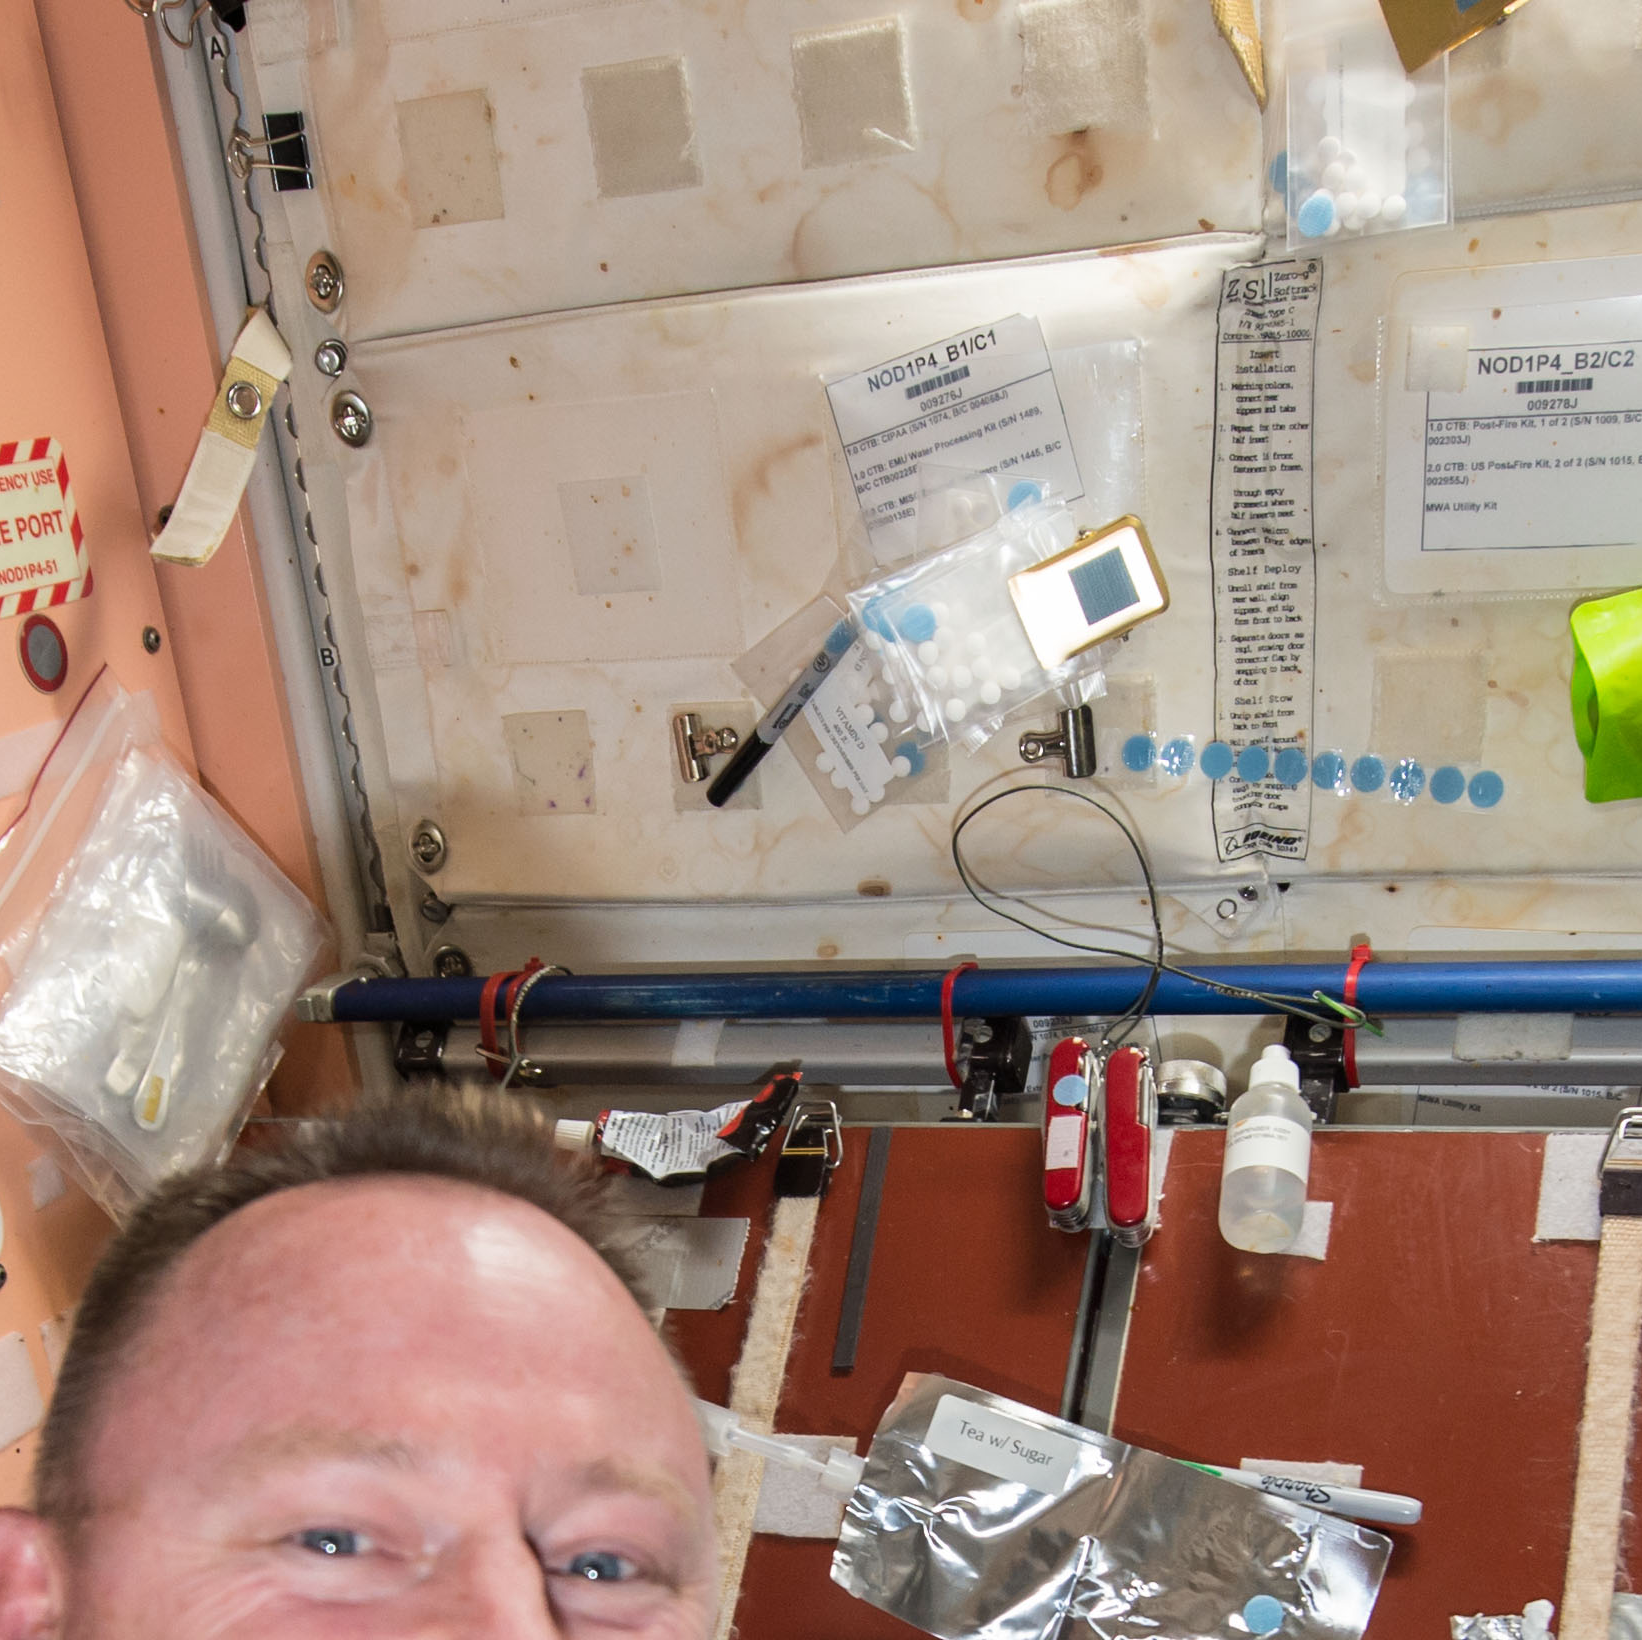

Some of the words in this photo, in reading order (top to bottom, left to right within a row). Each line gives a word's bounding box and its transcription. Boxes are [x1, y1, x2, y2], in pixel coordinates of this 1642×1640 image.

[209, 36, 225, 62] A
[867, 329, 998, 393] NOD1P4_B1/C1
[1477, 348, 1636, 376] NOD1P4_B2/C2
[919, 387, 964, 413] 009276J
[1526, 397, 1579, 412] 009278J
[1429, 421, 1444, 433] 1.0
[1444, 420, 1471, 432] CTB:
[1472, 418, 1519, 431] Post-Fire
[1519, 417, 1539, 430] Kit,
[1548, 416, 1560, 428] of
[1560, 416, 1568, 427] 2
[1569, 415, 1593, 428] (S/N
[1622, 412, 1642, 425] B/C
[888, 454, 909, 469] EMU
[908, 446, 935, 462] Water
[933, 426, 984, 456] Processing
[983, 421, 999, 436] Kit
[998, 413, 1019, 431] (S/N
[1043, 439, 1063, 454] B/C
[1426, 462, 1442, 474] 2.0
[1442, 461, 1469, 473] CTB:
[1470, 460, 1486, 472] US
[1487, 459, 1533, 472] Post-Fire
[1534, 457, 1553, 470] Kit,
[1554, 458, 1561, 468] 2
[1562, 456, 1575, 468] of
[1575, 456, 1584, 468] 2
[1583, 455, 1607, 469] (S/N
[30, 467, 56, 486] USE
[1425, 502, 1451, 513] MWA
[1452, 501, 1482, 514] Utility
[1483, 500, 1498, 512] Kit
[14, 508, 64, 542] PORT
[1227, 565, 1259, 577] Shelf
[1263, 563, 1303, 576] Deploy
[320, 646, 336, 667] B
[1233, 695, 1264, 706] Shelf
[1267, 694, 1295, 705] Stow
[834, 705, 862, 746] VITAMIN
[856, 742, 866, 751] D
[959, 1419, 987, 1443] Tea
[988, 1434, 1011, 1450] w/
[1010, 1438, 1055, 1467] Sugar
[1261, 1473, 1337, 1504] Sharpie
